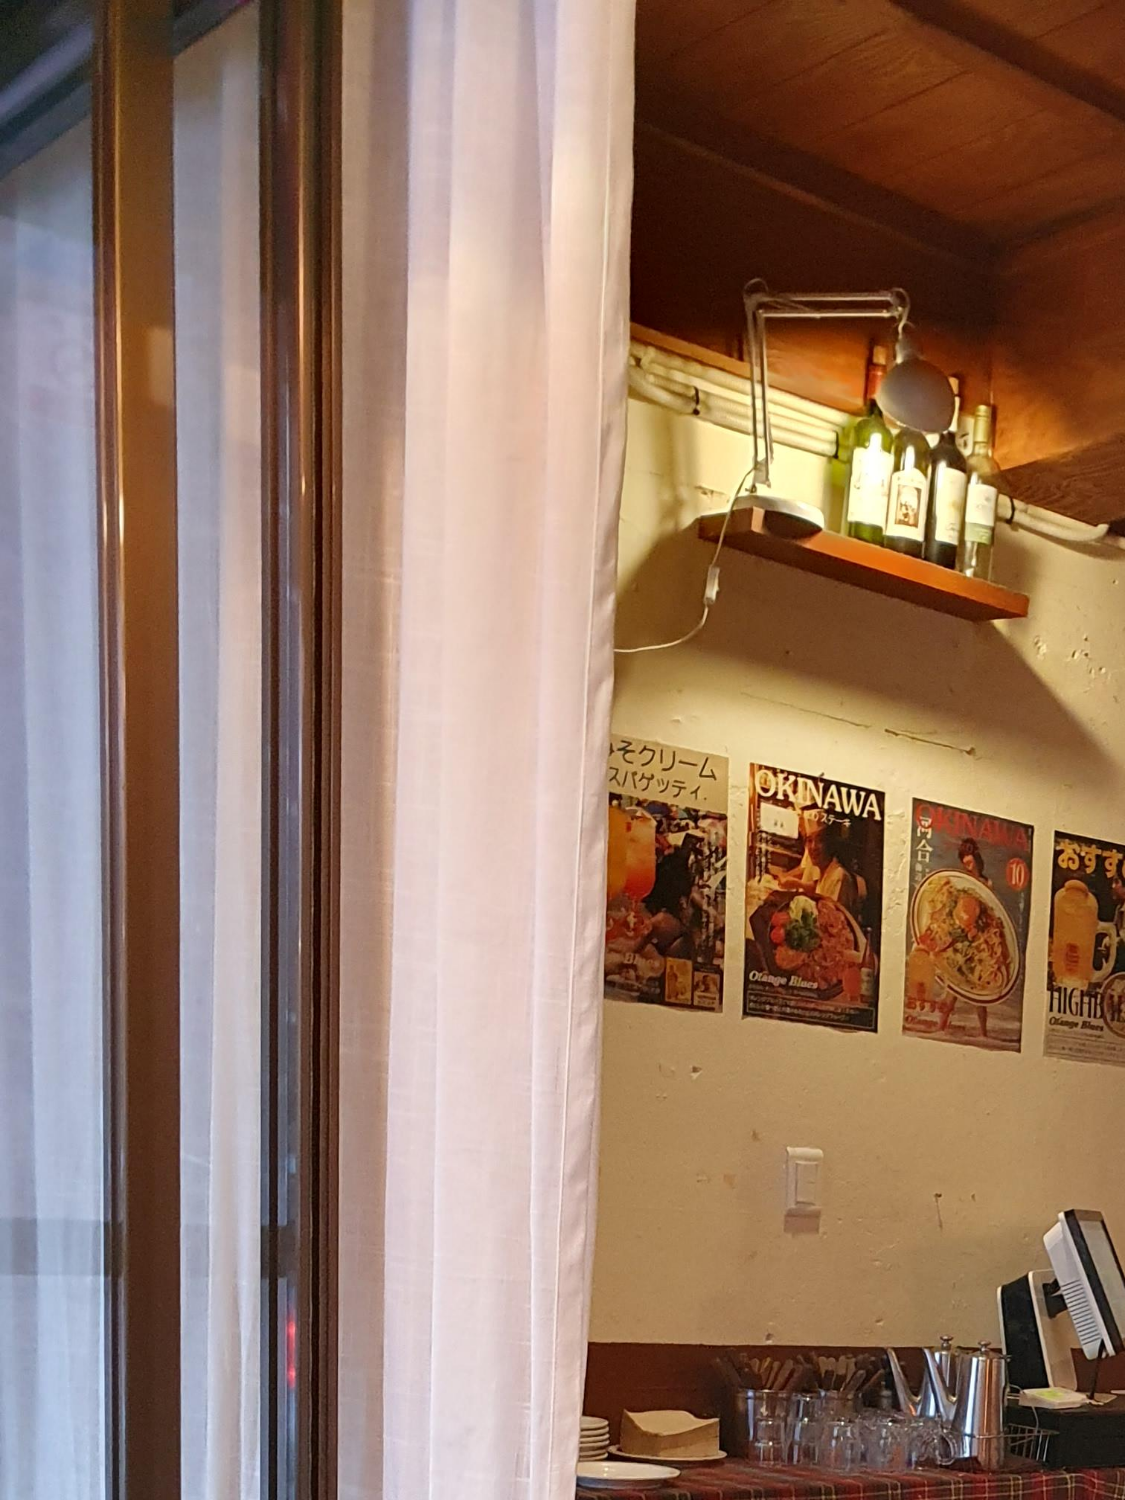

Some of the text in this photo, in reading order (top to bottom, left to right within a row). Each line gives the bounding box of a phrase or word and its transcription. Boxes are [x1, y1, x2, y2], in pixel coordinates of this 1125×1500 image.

[755, 769, 882, 821] OKINAWA
[915, 804, 1029, 852] OKINAWA
[1010, 863, 1025, 886] 10
[788, 975, 818, 989] Blues
